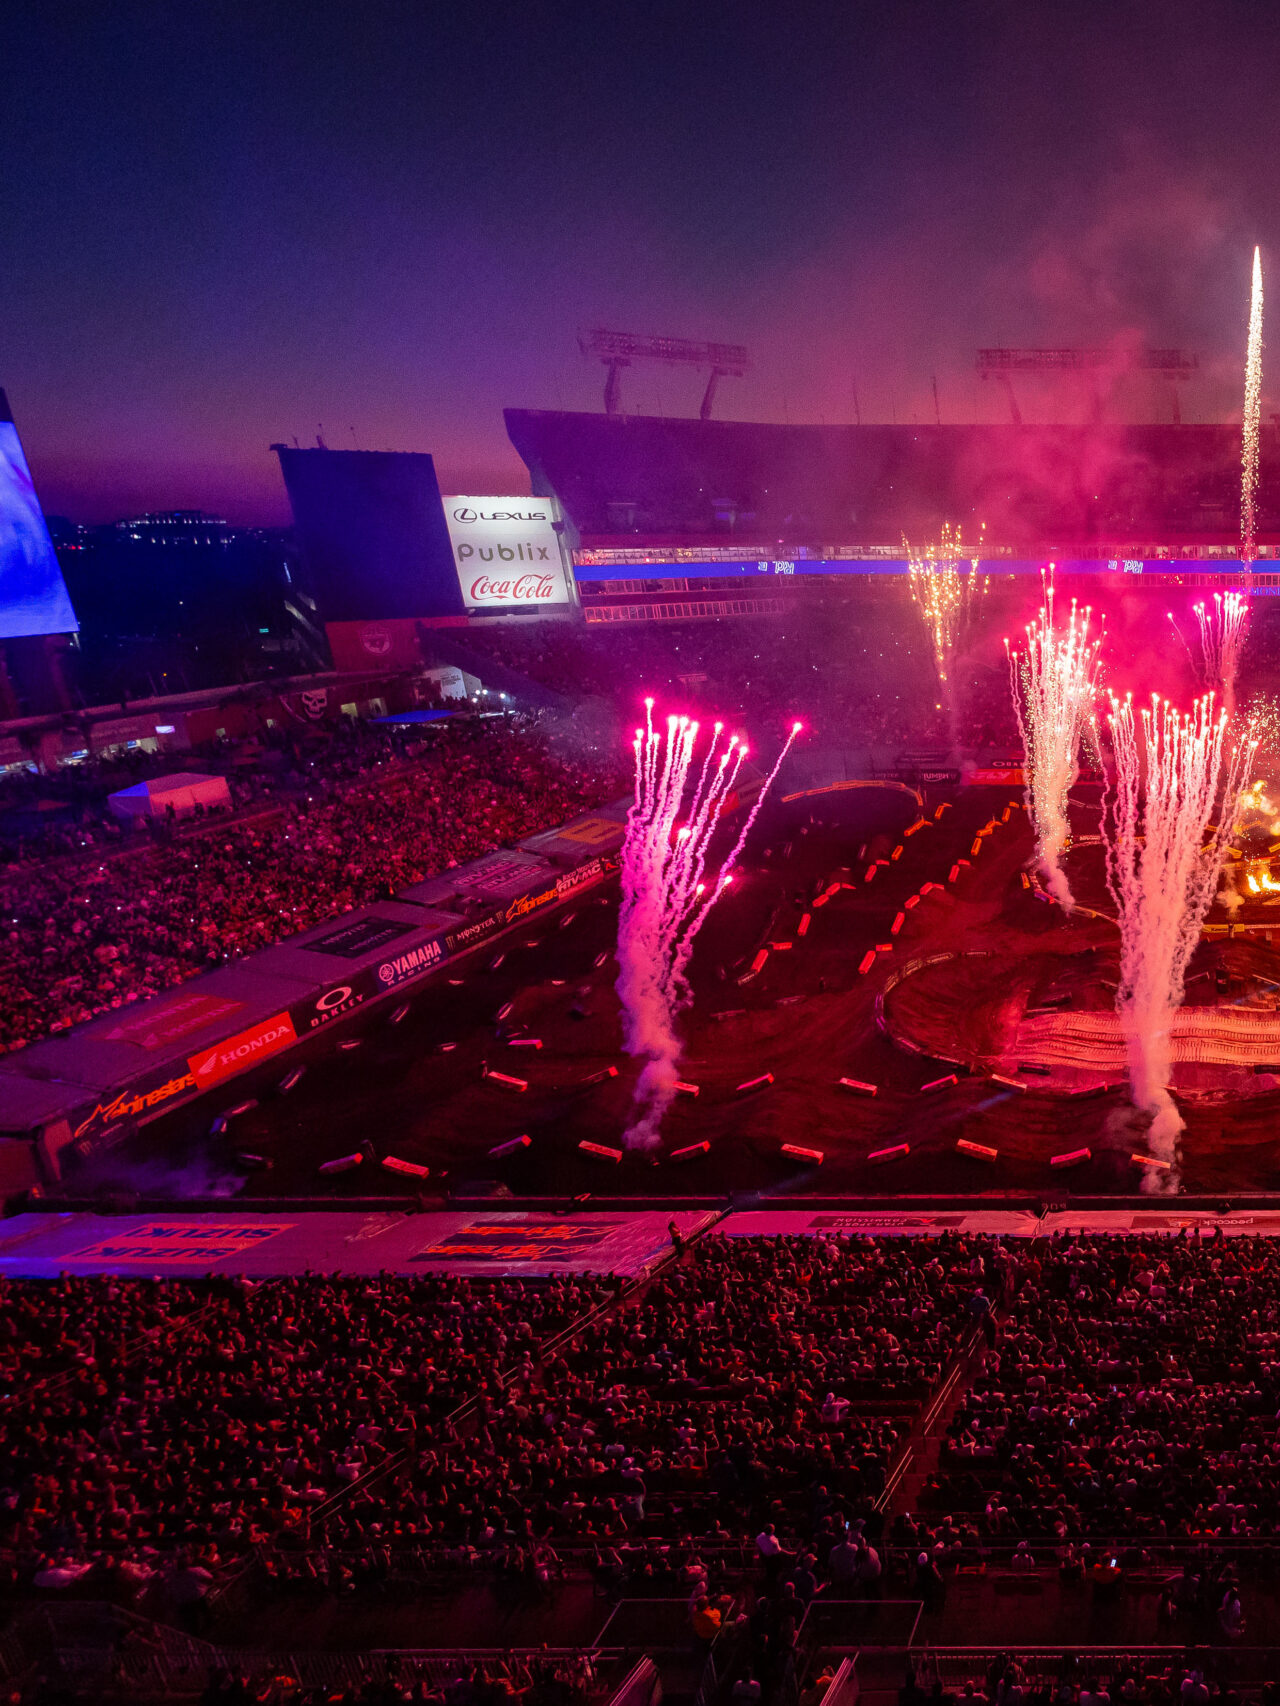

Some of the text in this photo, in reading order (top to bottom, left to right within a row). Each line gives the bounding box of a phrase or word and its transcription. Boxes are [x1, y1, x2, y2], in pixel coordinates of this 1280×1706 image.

[480, 512, 546, 520] LEXUS
[457, 543, 549, 561] Publix
[470, 574, 555, 600] Coca-Cola
[457, 918, 495, 940] MONSTER
[392, 940, 441, 974] YAMAHA
[311, 994, 364, 1027] OAKLEY
[220, 1026, 291, 1066] HONDA
[1203, 1218, 1254, 1227] peacock
